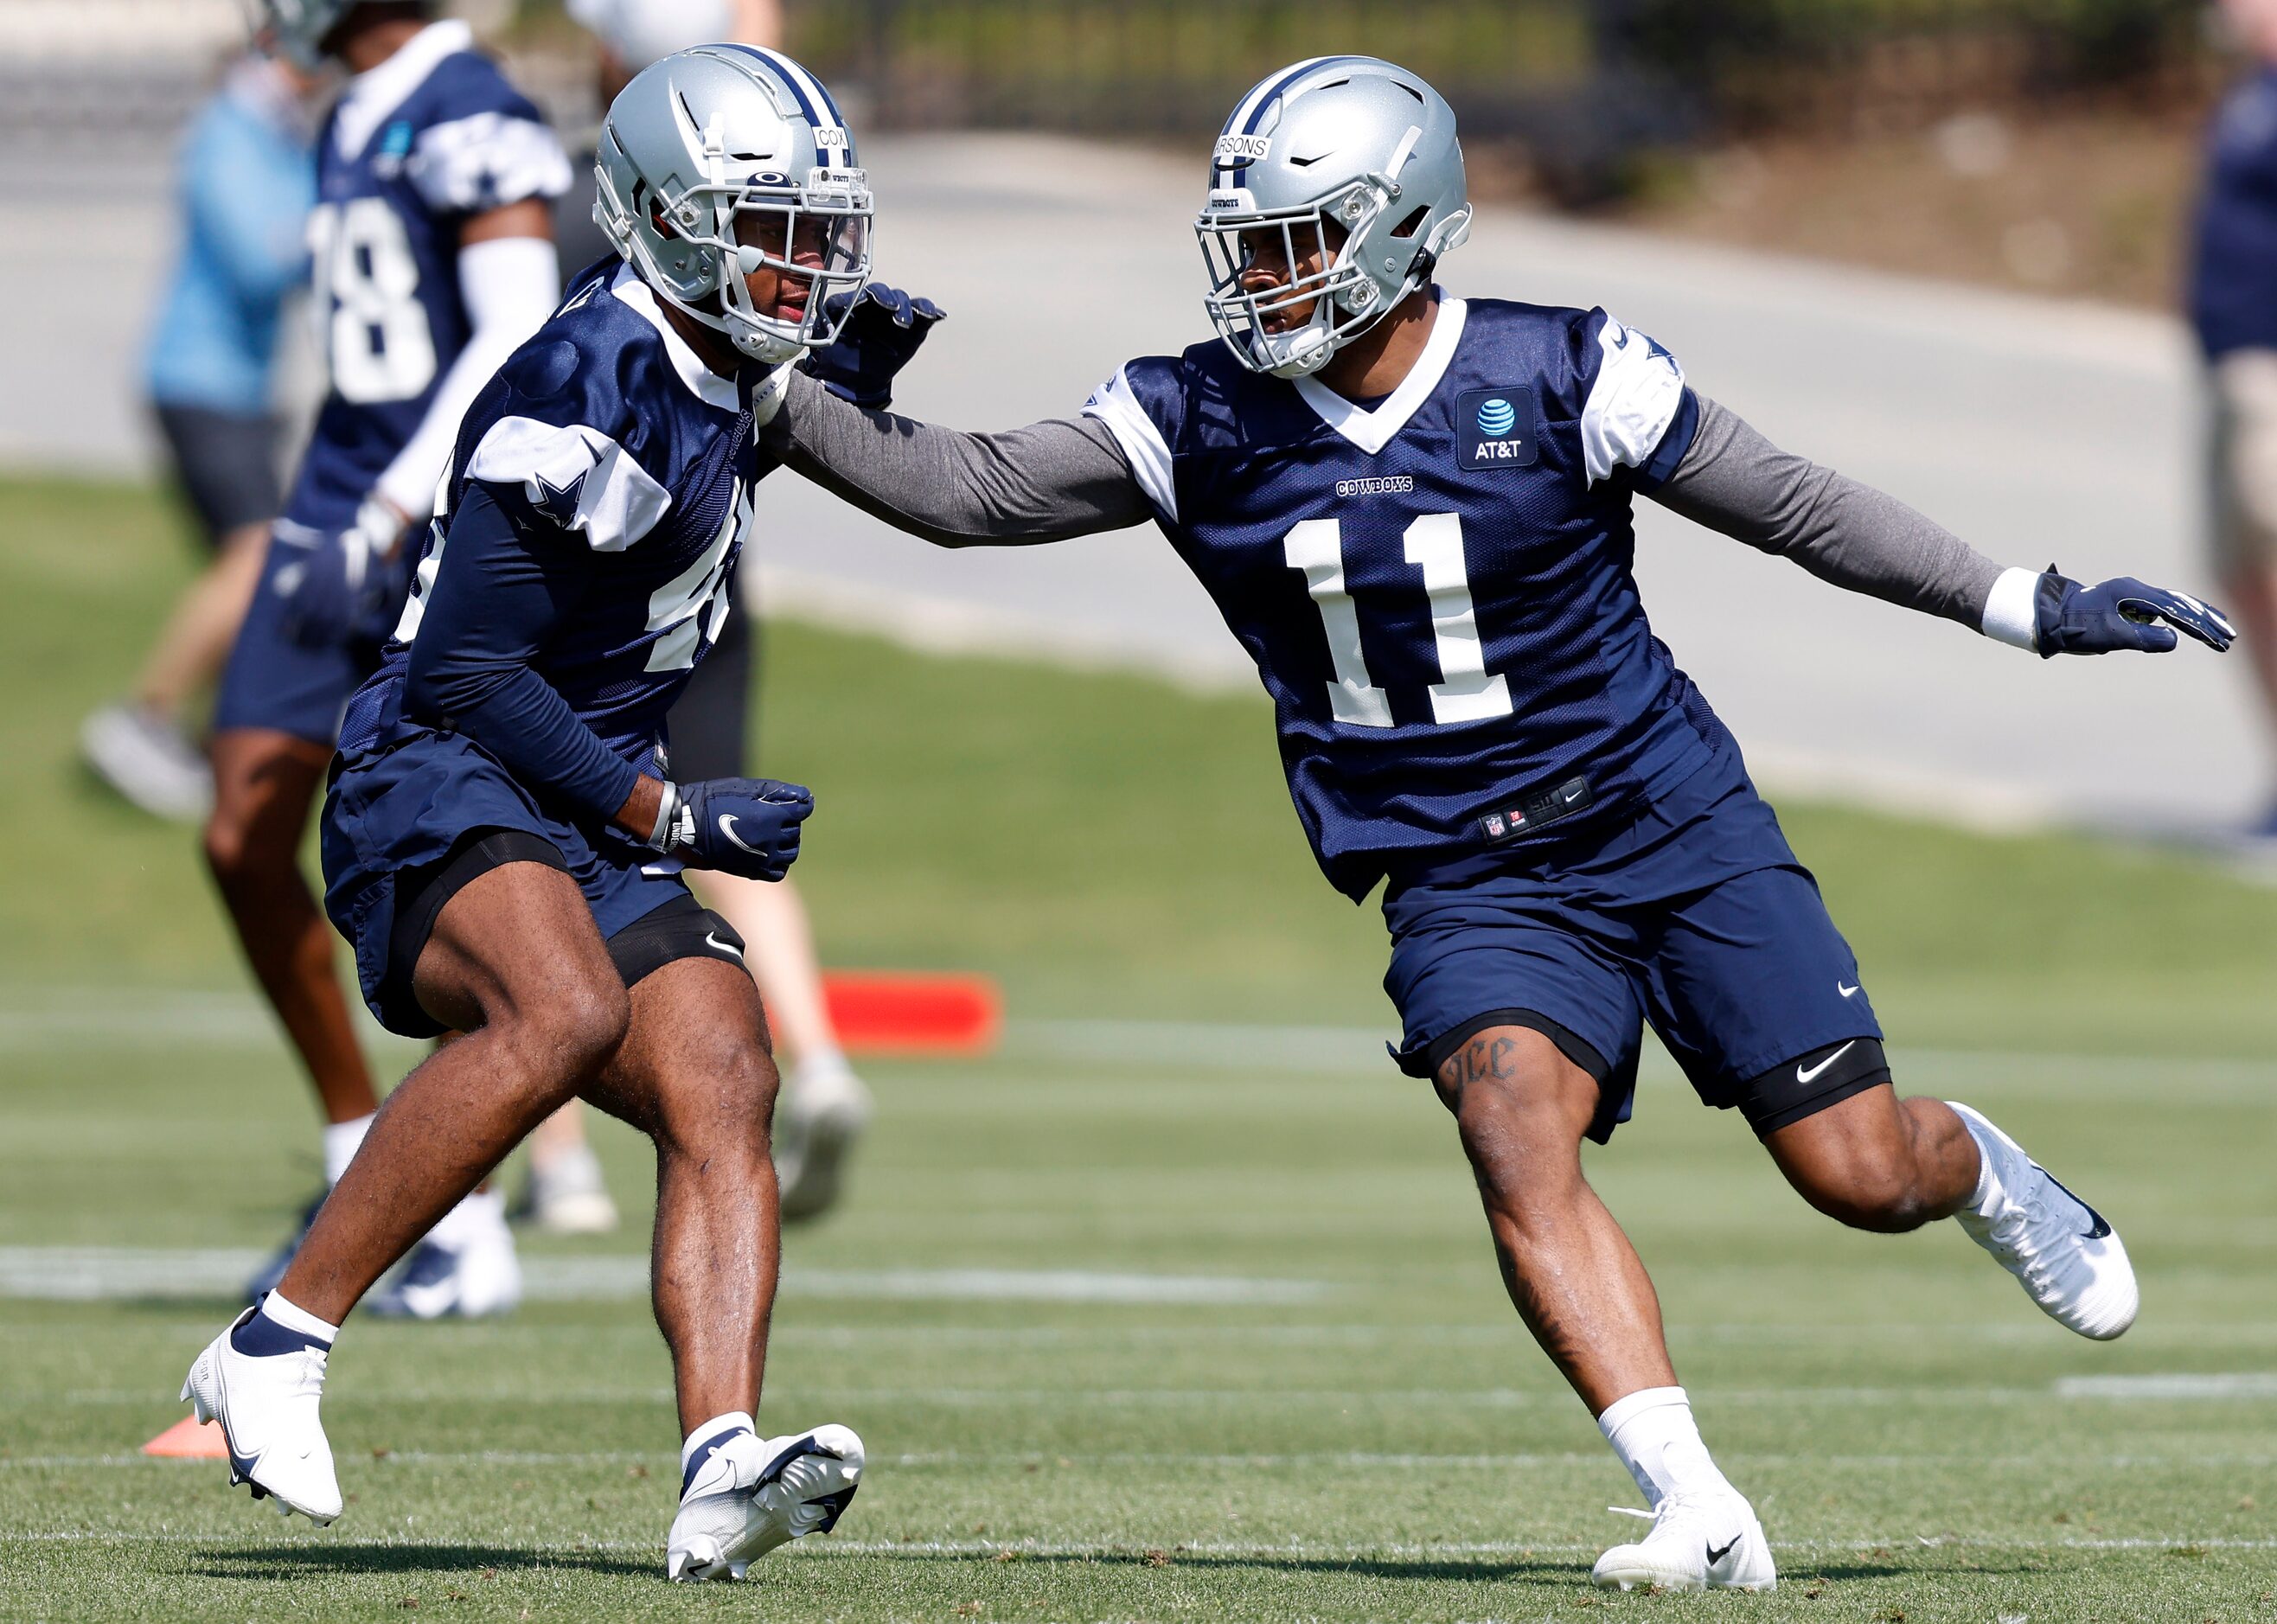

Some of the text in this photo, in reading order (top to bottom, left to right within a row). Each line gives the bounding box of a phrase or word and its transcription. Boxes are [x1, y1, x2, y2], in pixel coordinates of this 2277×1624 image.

[819, 130, 846, 145] COX
[1213, 137, 1266, 156] ARSONS
[1212, 199, 1238, 208] COWBOYS
[1475, 440, 1521, 460] AT&T
[1336, 476, 1413, 496] COWBOYS
[1283, 513, 1513, 727] 11
